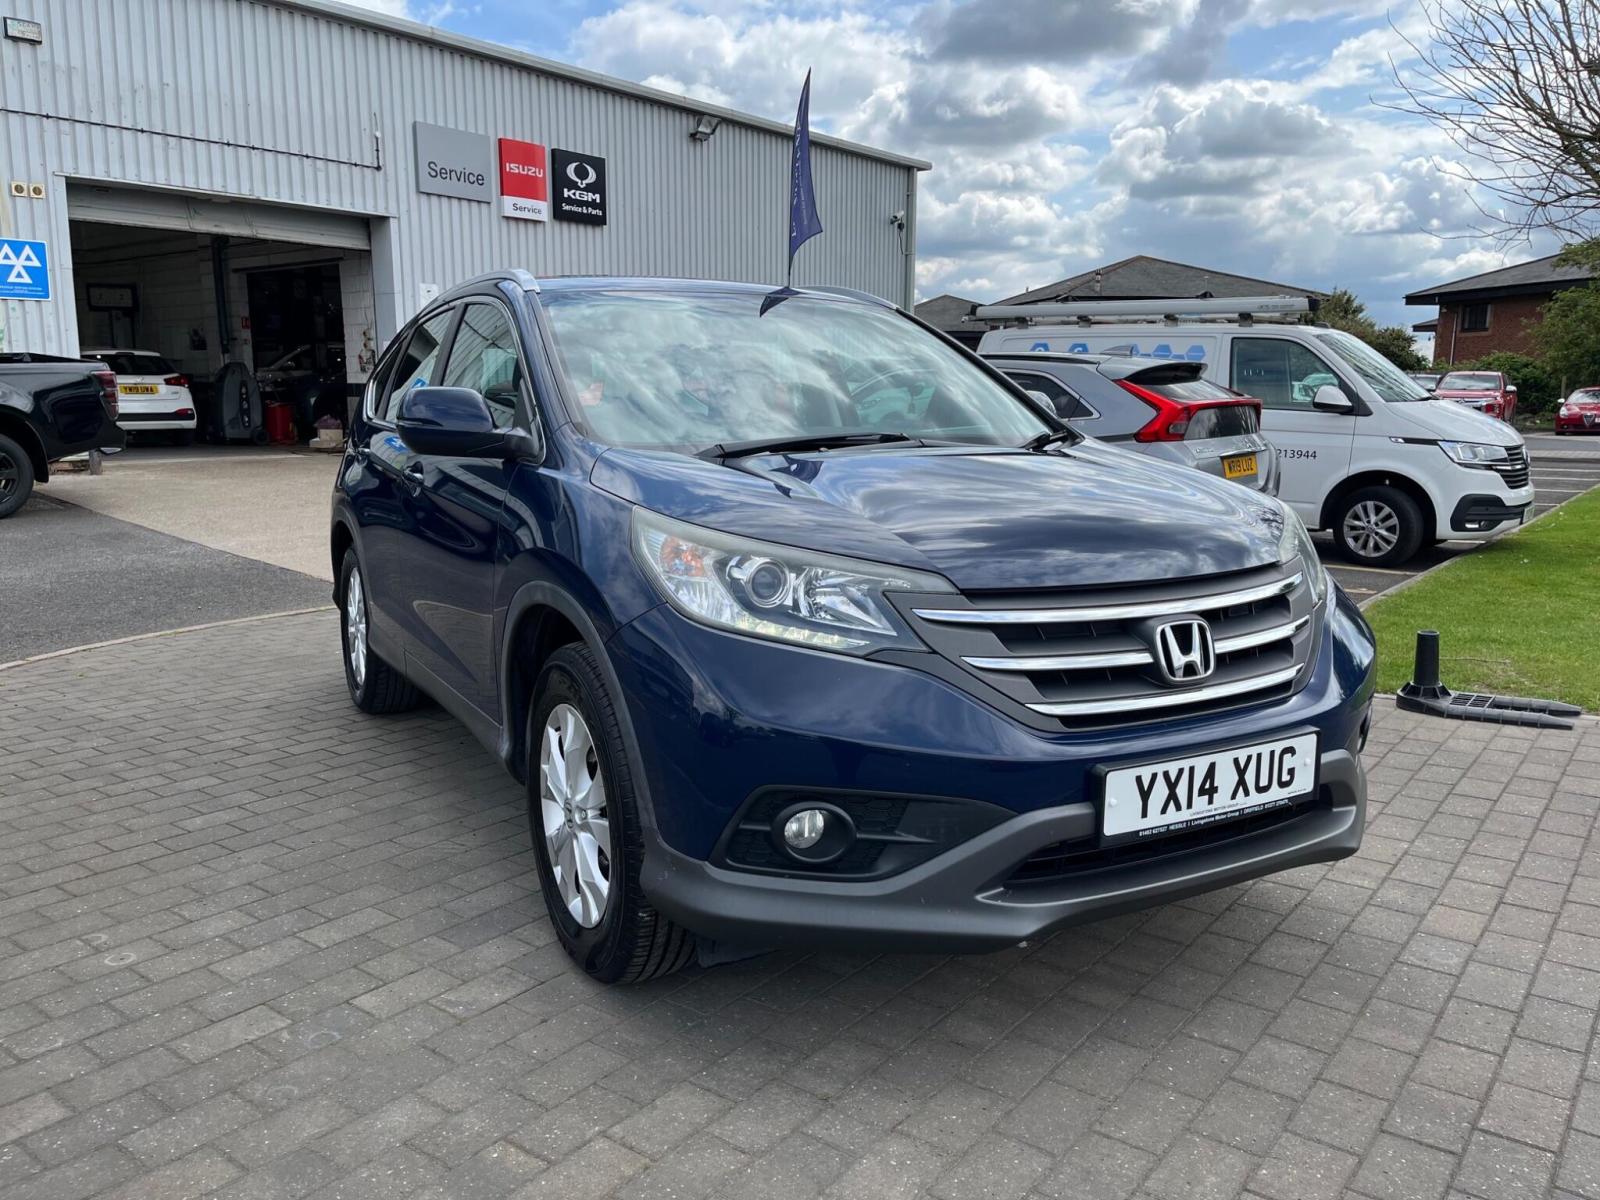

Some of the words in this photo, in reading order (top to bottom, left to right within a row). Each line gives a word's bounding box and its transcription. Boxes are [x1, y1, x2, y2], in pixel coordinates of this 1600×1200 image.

[427, 160, 485, 186] Service
[505, 162, 544, 178] ISUZU
[563, 187, 601, 203] KGM
[512, 202, 542, 215] Service
[561, 202, 582, 213] Service
[588, 207, 603, 216] Parts
[1135, 761, 1219, 819] YX14
[1230, 746, 1297, 800] XUG
